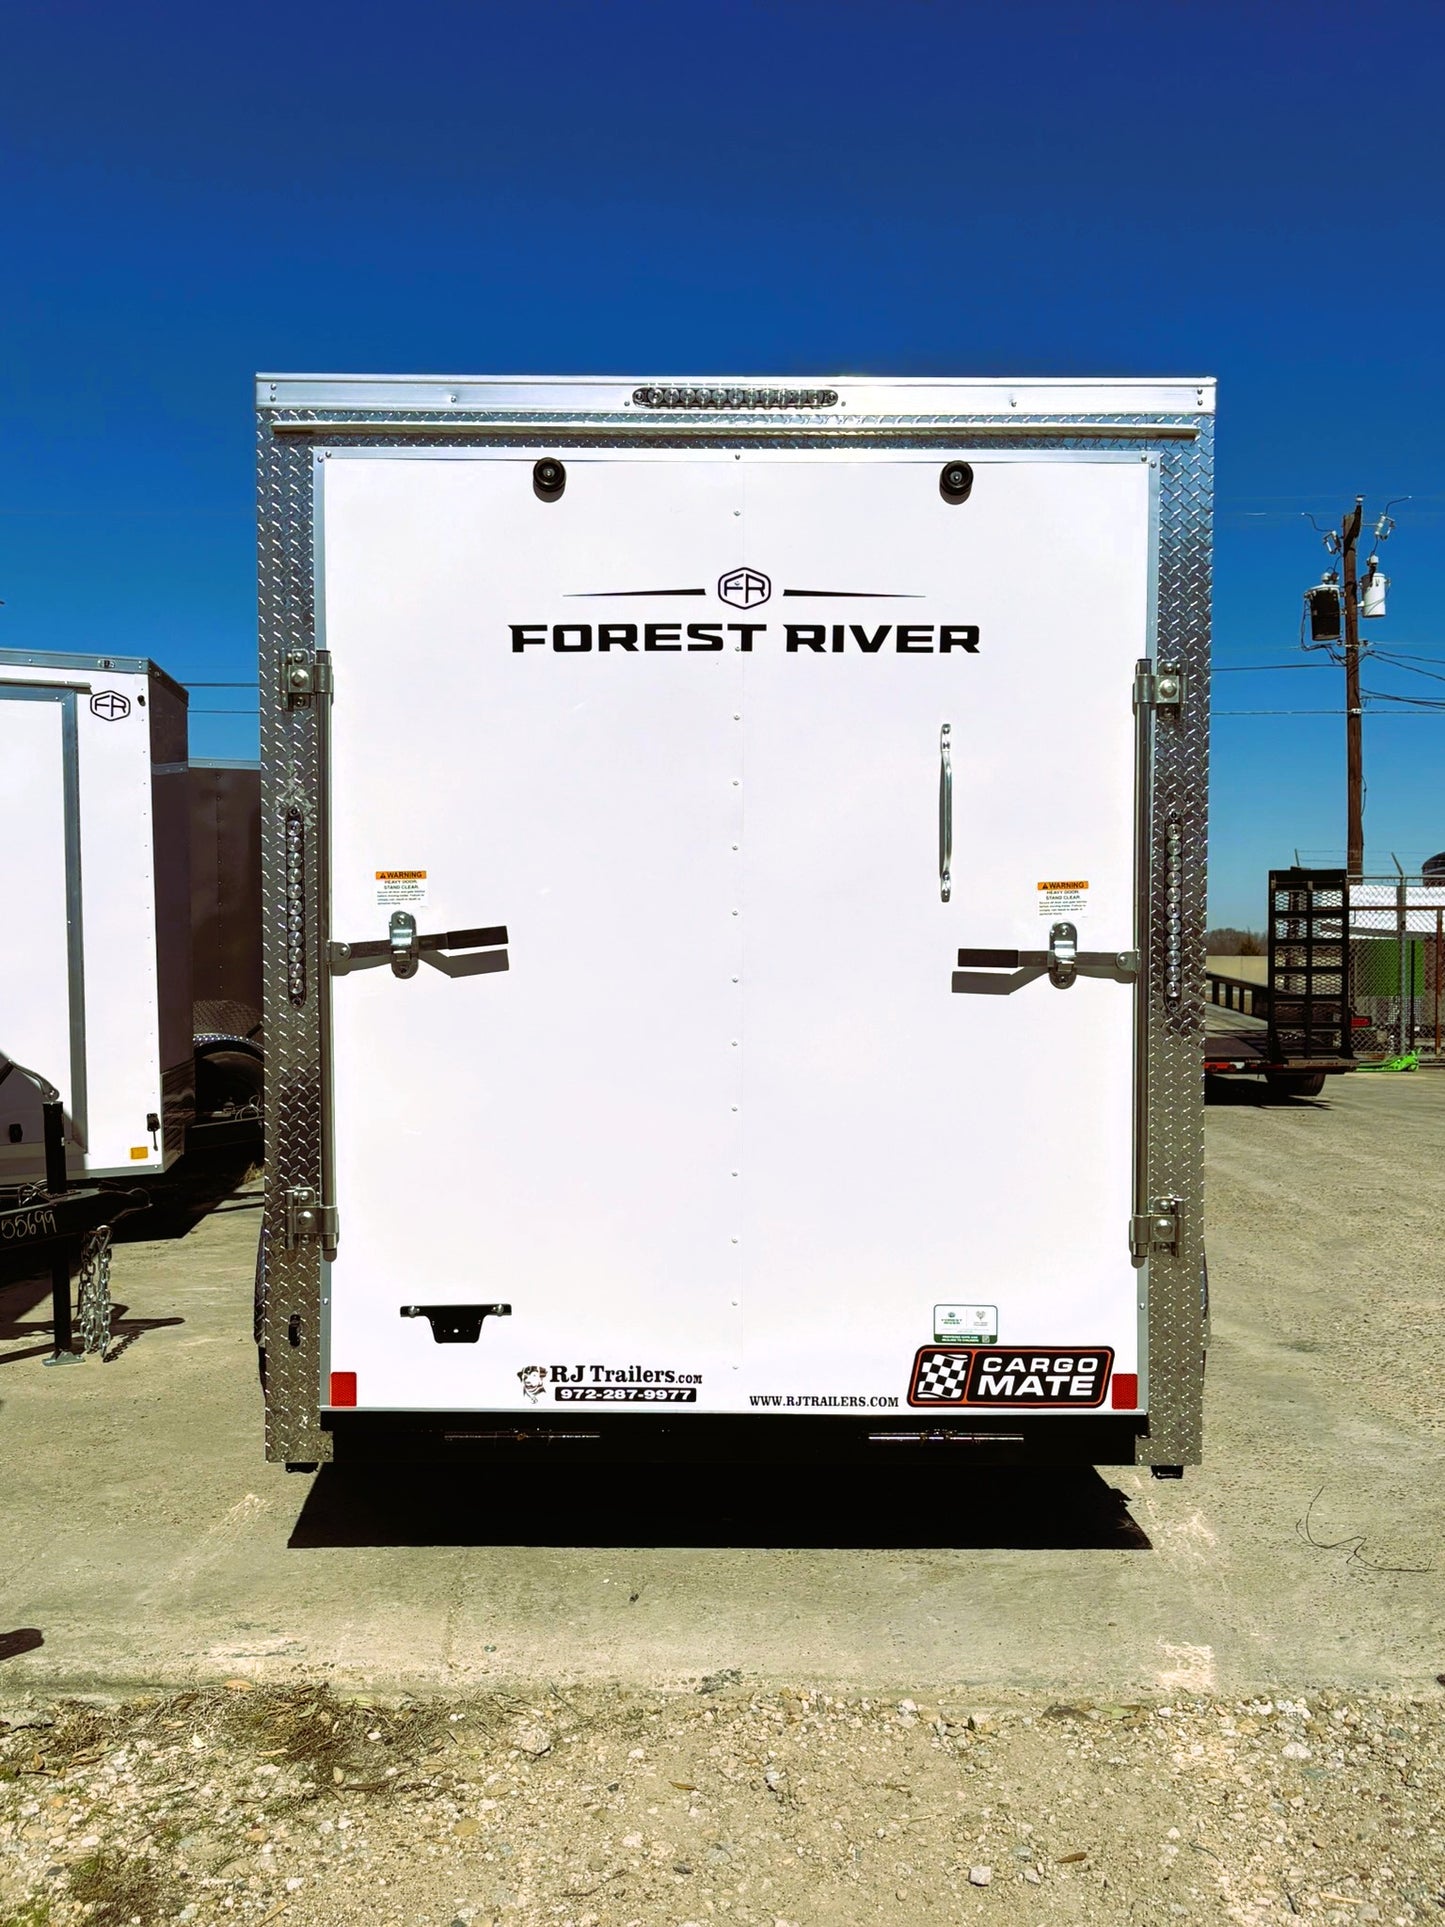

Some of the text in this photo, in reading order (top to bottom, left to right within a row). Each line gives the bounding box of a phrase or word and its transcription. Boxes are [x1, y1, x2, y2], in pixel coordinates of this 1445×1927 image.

[724, 574, 766, 605] FR
[508, 624, 981, 653] FOREST RIVER
[94, 694, 127, 717] FR
[1049, 881, 1084, 889] WARNING
[1, 1210, 57, 1239] 55699
[550, 1365, 586, 1383] RJ
[982, 1357, 1098, 1373] CARGO
[560, 1388, 692, 1400] 972-287-9977
[977, 1375, 1095, 1396] MATE
[750, 1396, 899, 1408] WWW.RJTRAILERS.COM
